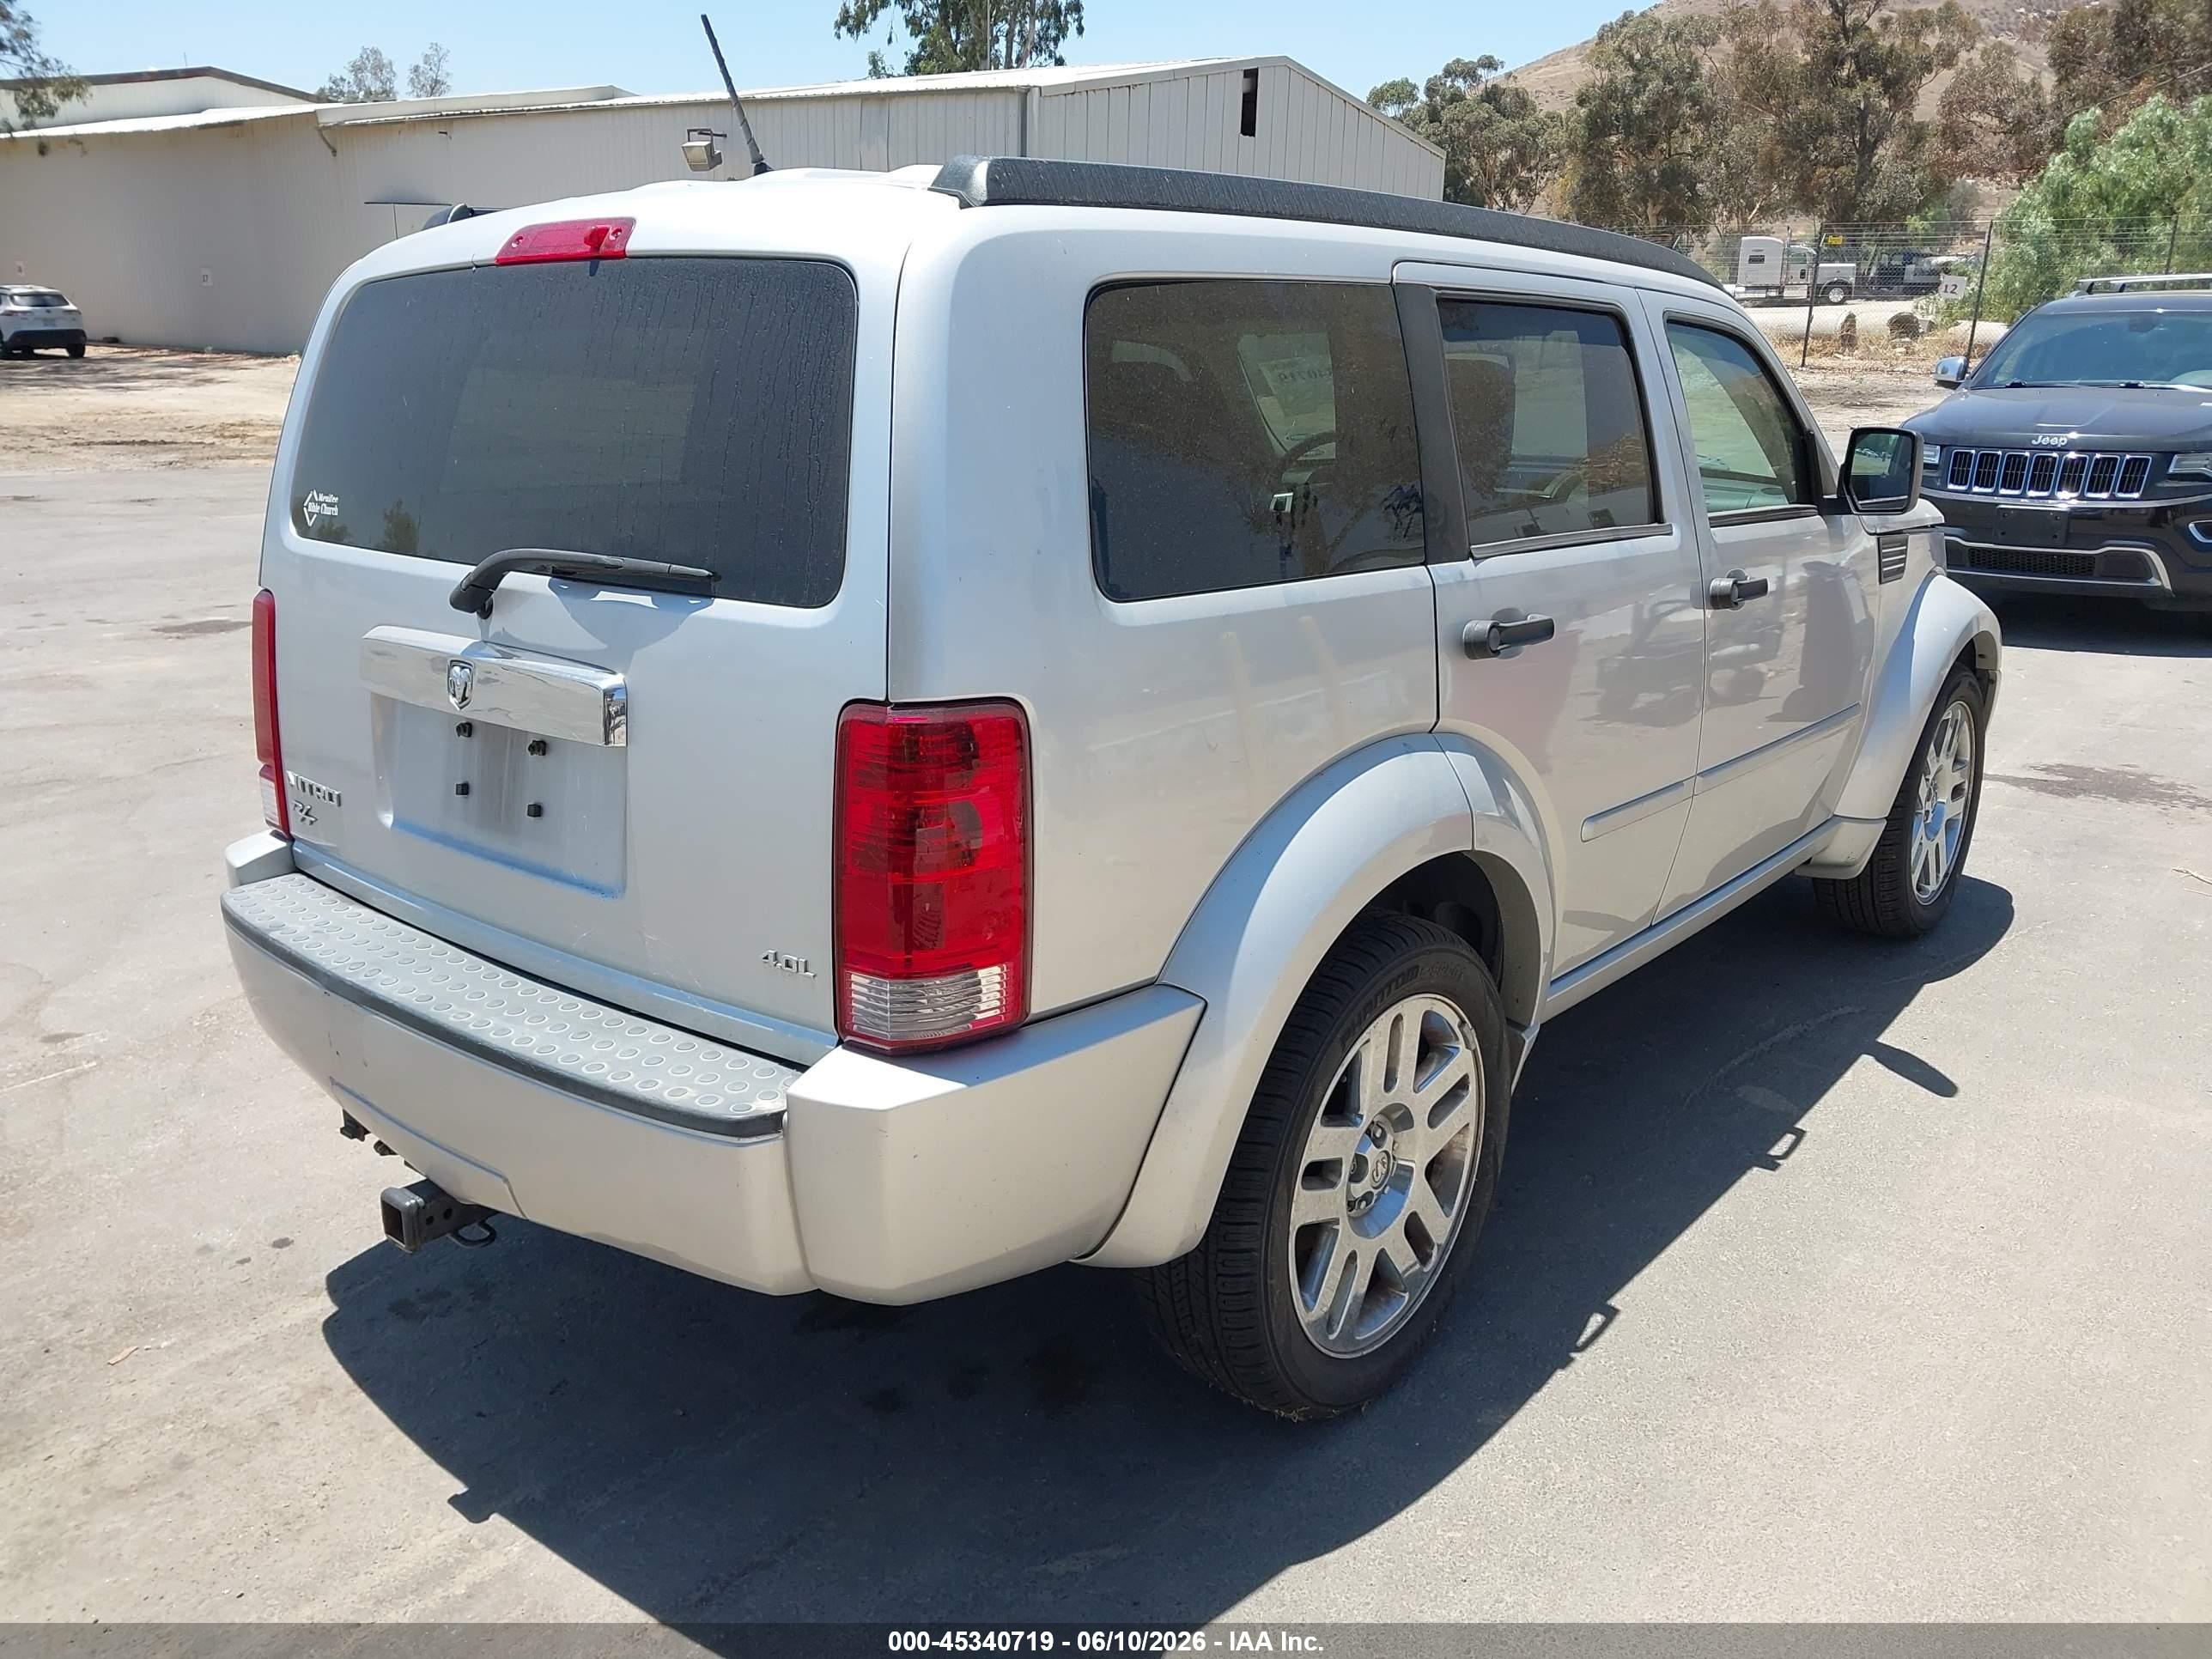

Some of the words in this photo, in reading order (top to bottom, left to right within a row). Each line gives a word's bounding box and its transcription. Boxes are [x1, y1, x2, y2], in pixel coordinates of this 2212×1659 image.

[1942, 283, 1959, 295] 12
[2031, 434, 2068, 447] Jeep
[319, 492, 339, 503] Menifee
[307, 501, 320, 514] Bible
[320, 502, 338, 516] Church
[286, 769, 342, 807] NITRO
[761, 949, 817, 981] 4.0L
